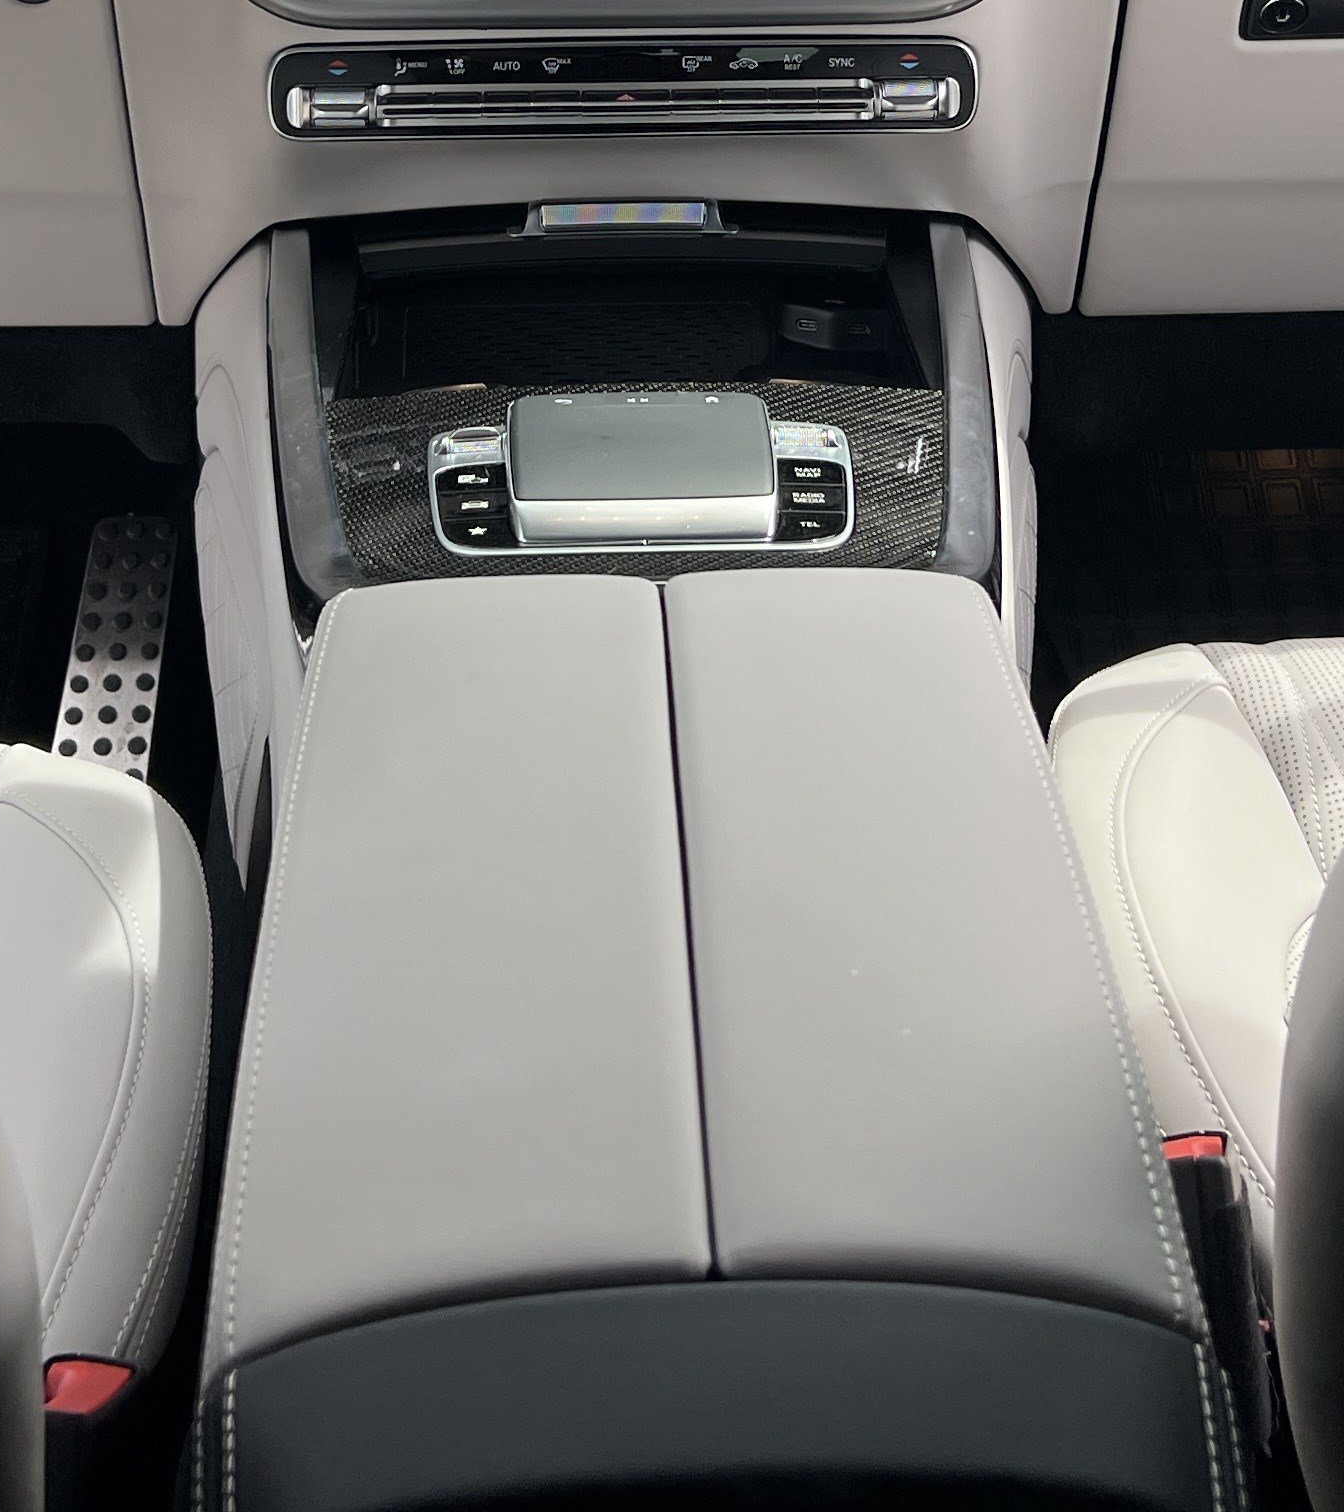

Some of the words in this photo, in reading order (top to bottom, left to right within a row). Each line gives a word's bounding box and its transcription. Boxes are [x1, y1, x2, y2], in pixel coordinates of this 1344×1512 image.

[557, 57, 572, 66] MAX
[783, 53, 803, 64] A/C
[828, 57, 855, 68] SYNC
[492, 60, 521, 72] AUTO
[794, 466, 822, 474] NAVI
[792, 491, 826, 499] RADIO
[799, 520, 821, 529] TEL
